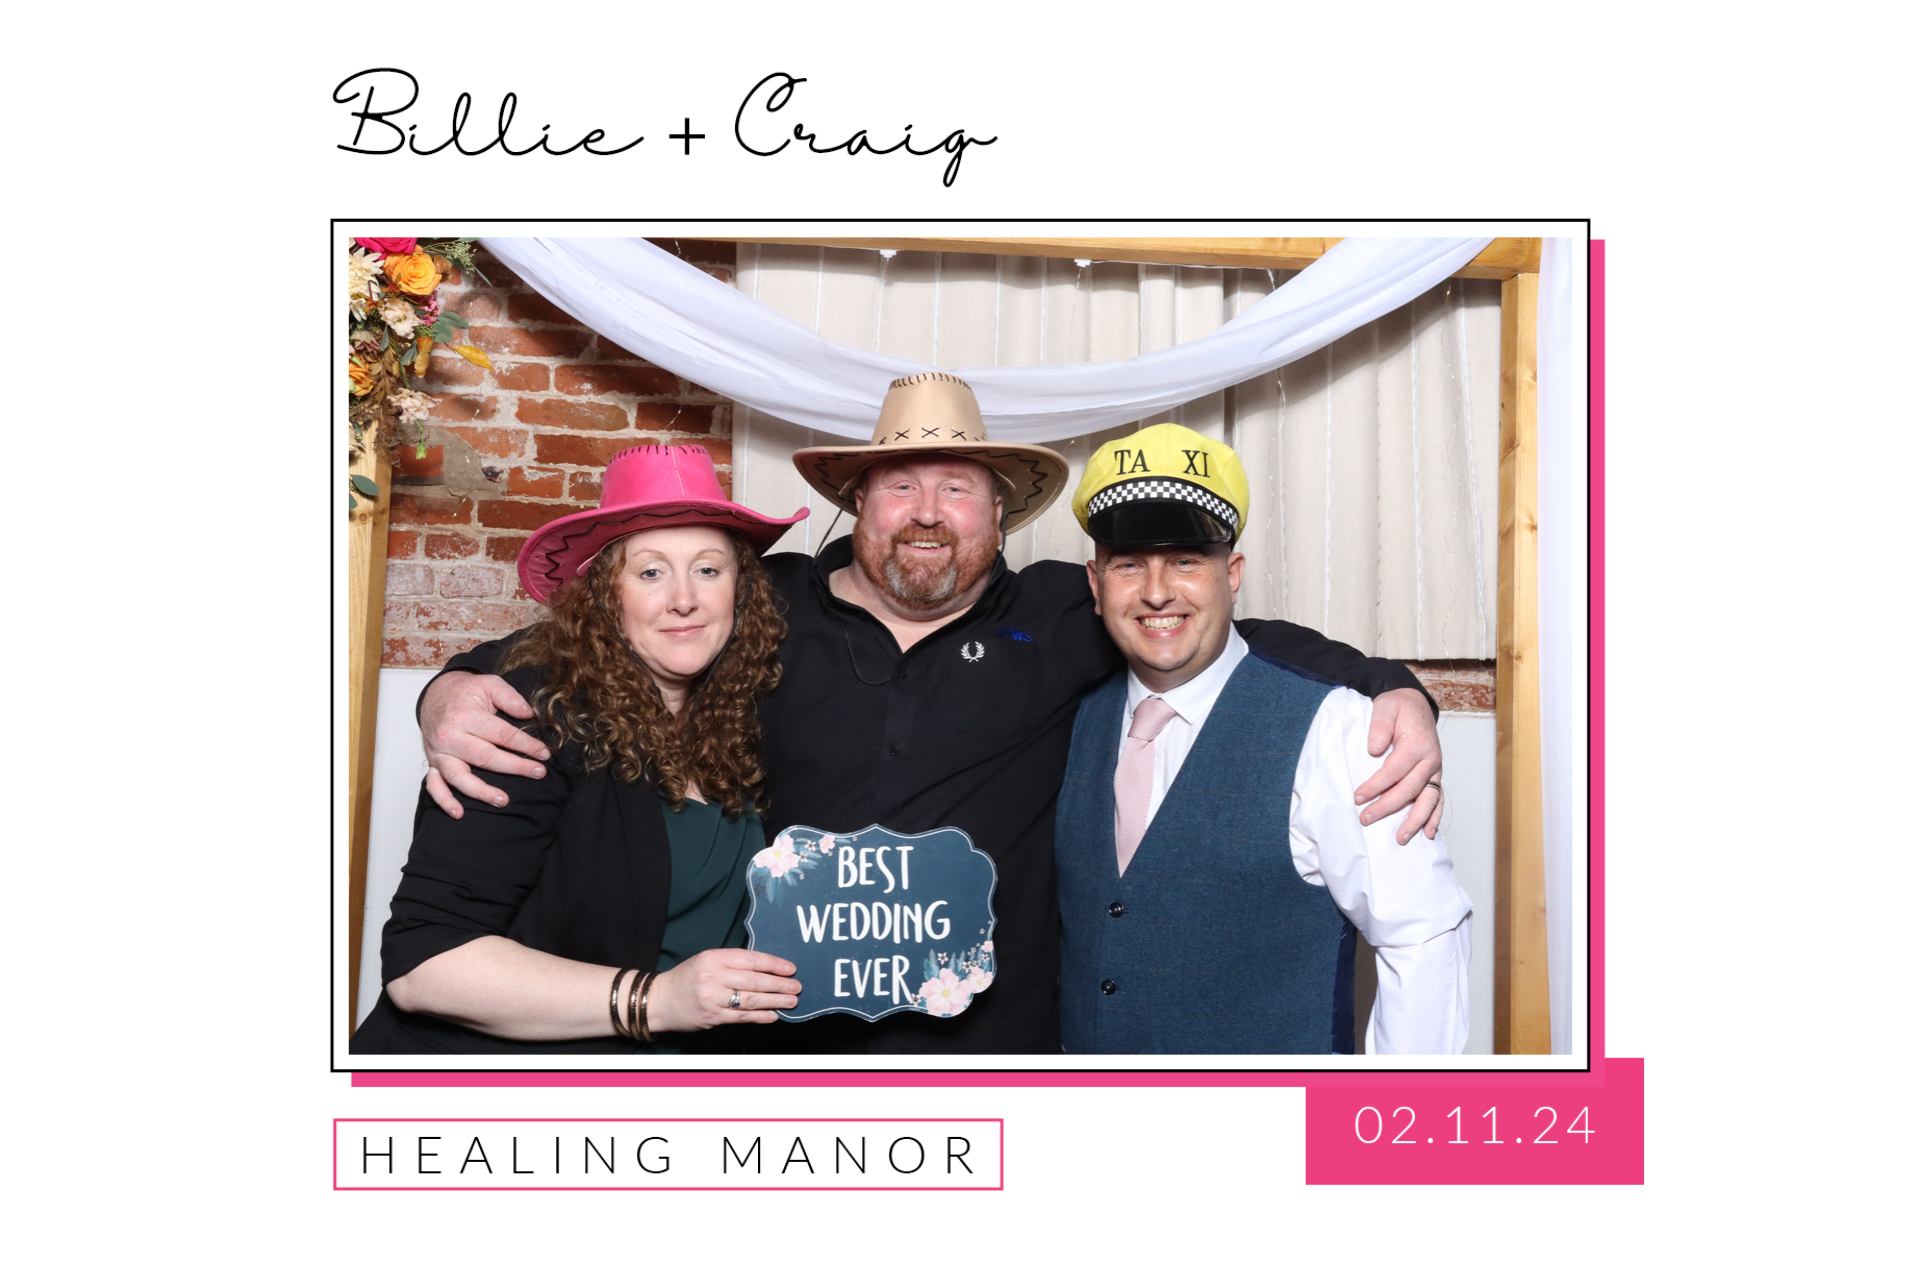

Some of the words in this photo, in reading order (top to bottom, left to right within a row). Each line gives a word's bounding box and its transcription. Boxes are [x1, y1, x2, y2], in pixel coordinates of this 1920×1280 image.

[837, 845, 914, 894] BEST
[796, 900, 951, 944] WEDDING
[834, 955, 913, 1005] EVER
